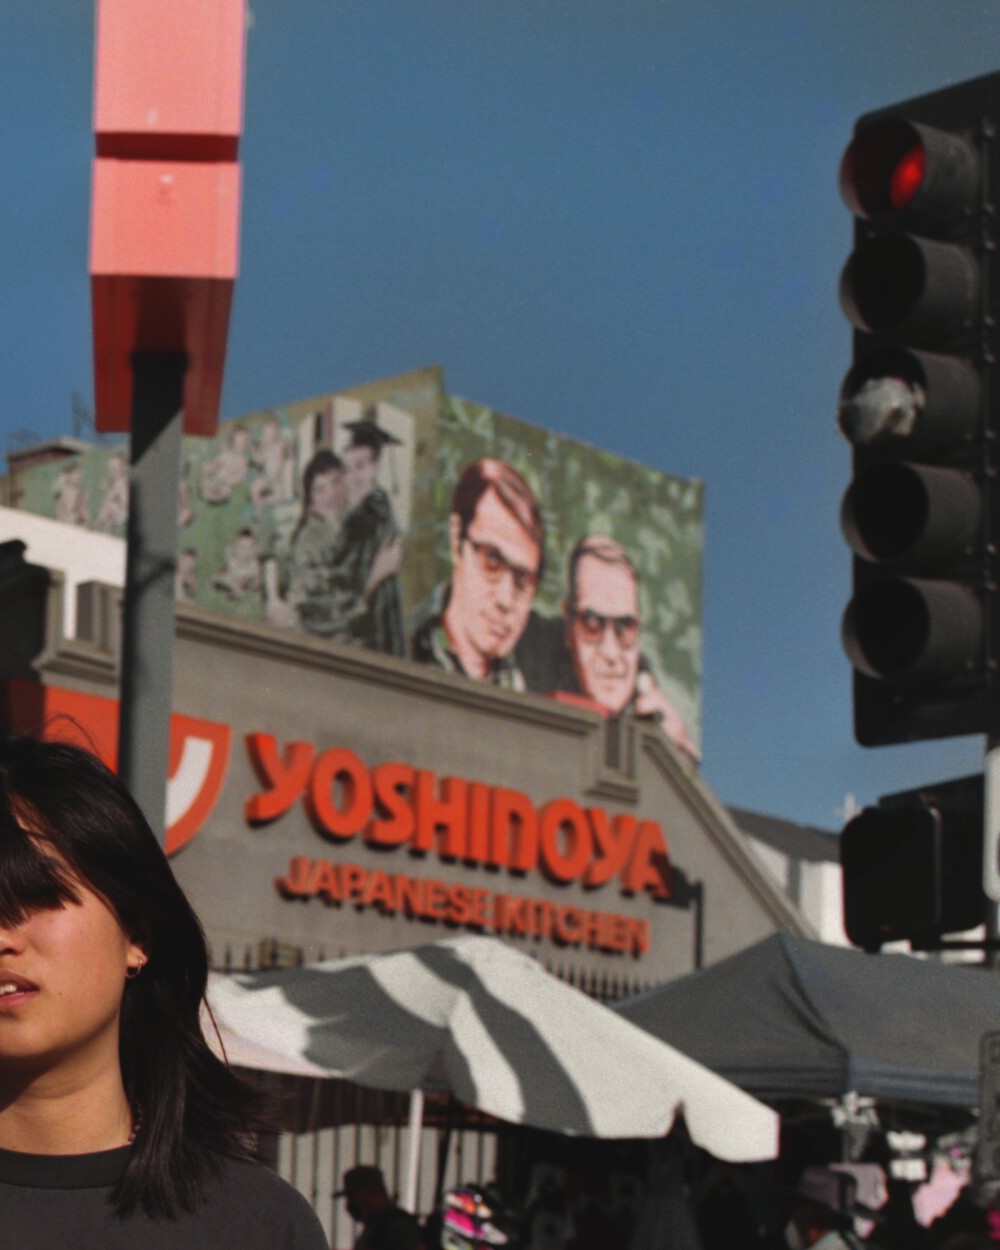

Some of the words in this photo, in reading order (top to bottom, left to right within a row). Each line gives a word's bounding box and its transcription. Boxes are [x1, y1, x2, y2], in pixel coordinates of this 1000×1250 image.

[244, 731, 671, 899] YOSHINOYA
[274, 856, 491, 931] JAPANESE
[494, 893, 650, 955] KITCHEN
